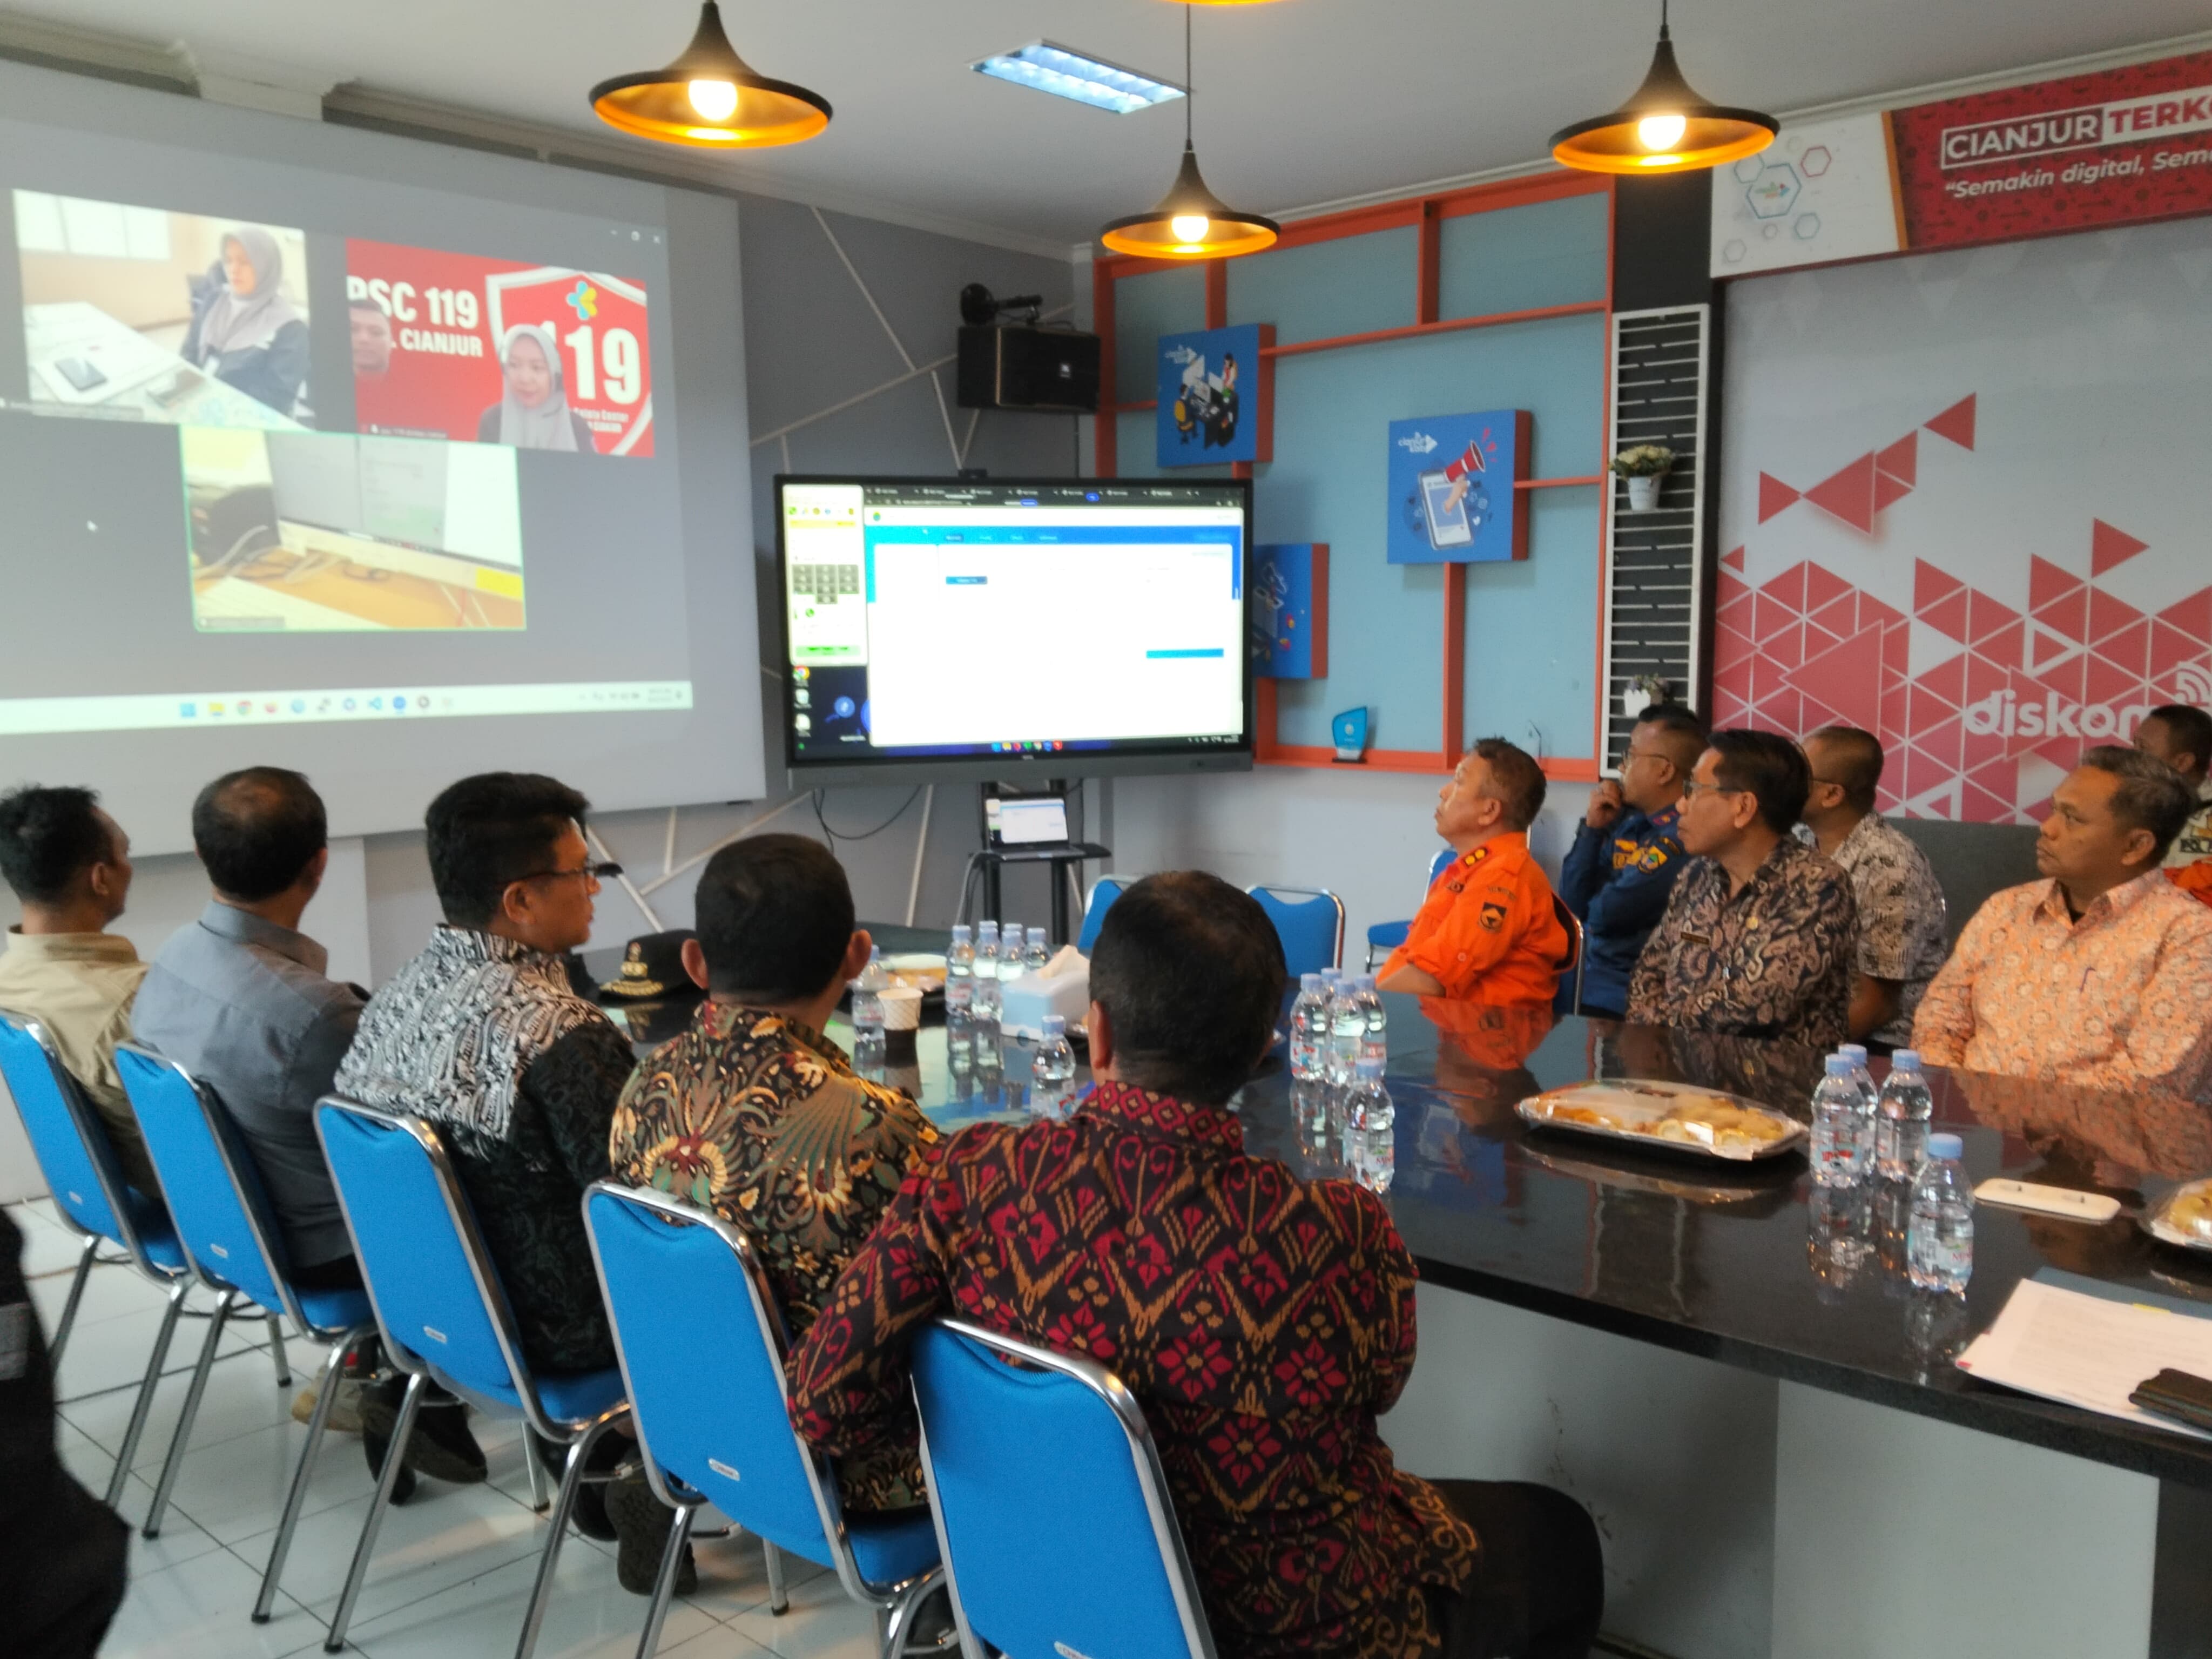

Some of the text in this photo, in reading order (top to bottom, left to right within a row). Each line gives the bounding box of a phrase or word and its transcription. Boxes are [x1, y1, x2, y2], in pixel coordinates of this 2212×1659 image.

[1946, 94, 2212, 160] CIANJUR TERK
[2061, 155, 2144, 184] digital,
[2151, 149, 2212, 171] Sem
[346, 275, 479, 329] PSC 119
[400, 328, 483, 358] CIANJUR
